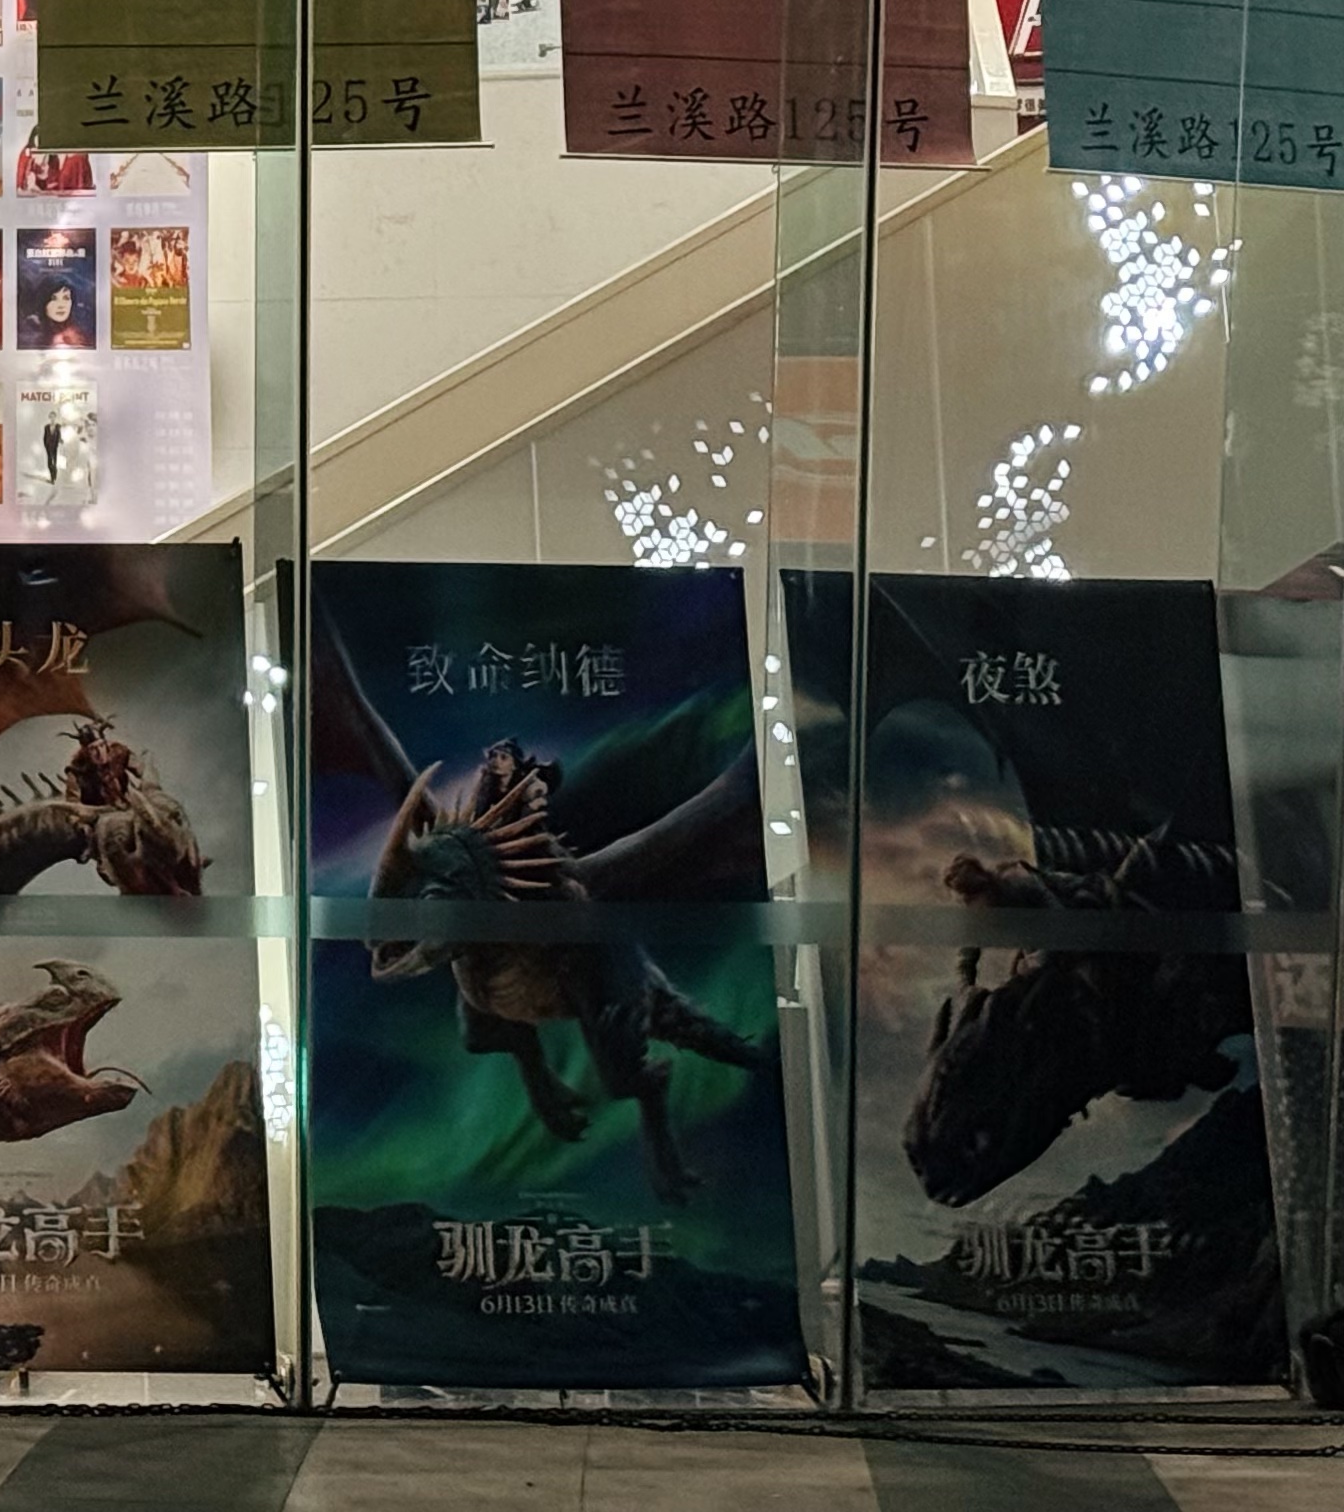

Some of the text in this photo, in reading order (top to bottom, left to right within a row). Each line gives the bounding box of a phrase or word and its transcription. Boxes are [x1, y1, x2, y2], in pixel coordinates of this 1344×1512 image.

[81, 74, 431, 133] 兰溪路25号
[607, 84, 929, 153] 兰溪路125号
[1080, 101, 1343, 178] 兰溪路125号
[406, 641, 628, 698] 致命纳德
[958, 650, 1064, 707] 夜煞
[432, 1220, 675, 1290] 驯龙高手
[957, 1220, 1174, 1287] 驯龙高手
[480, 1295, 555, 1316] 6月13日
